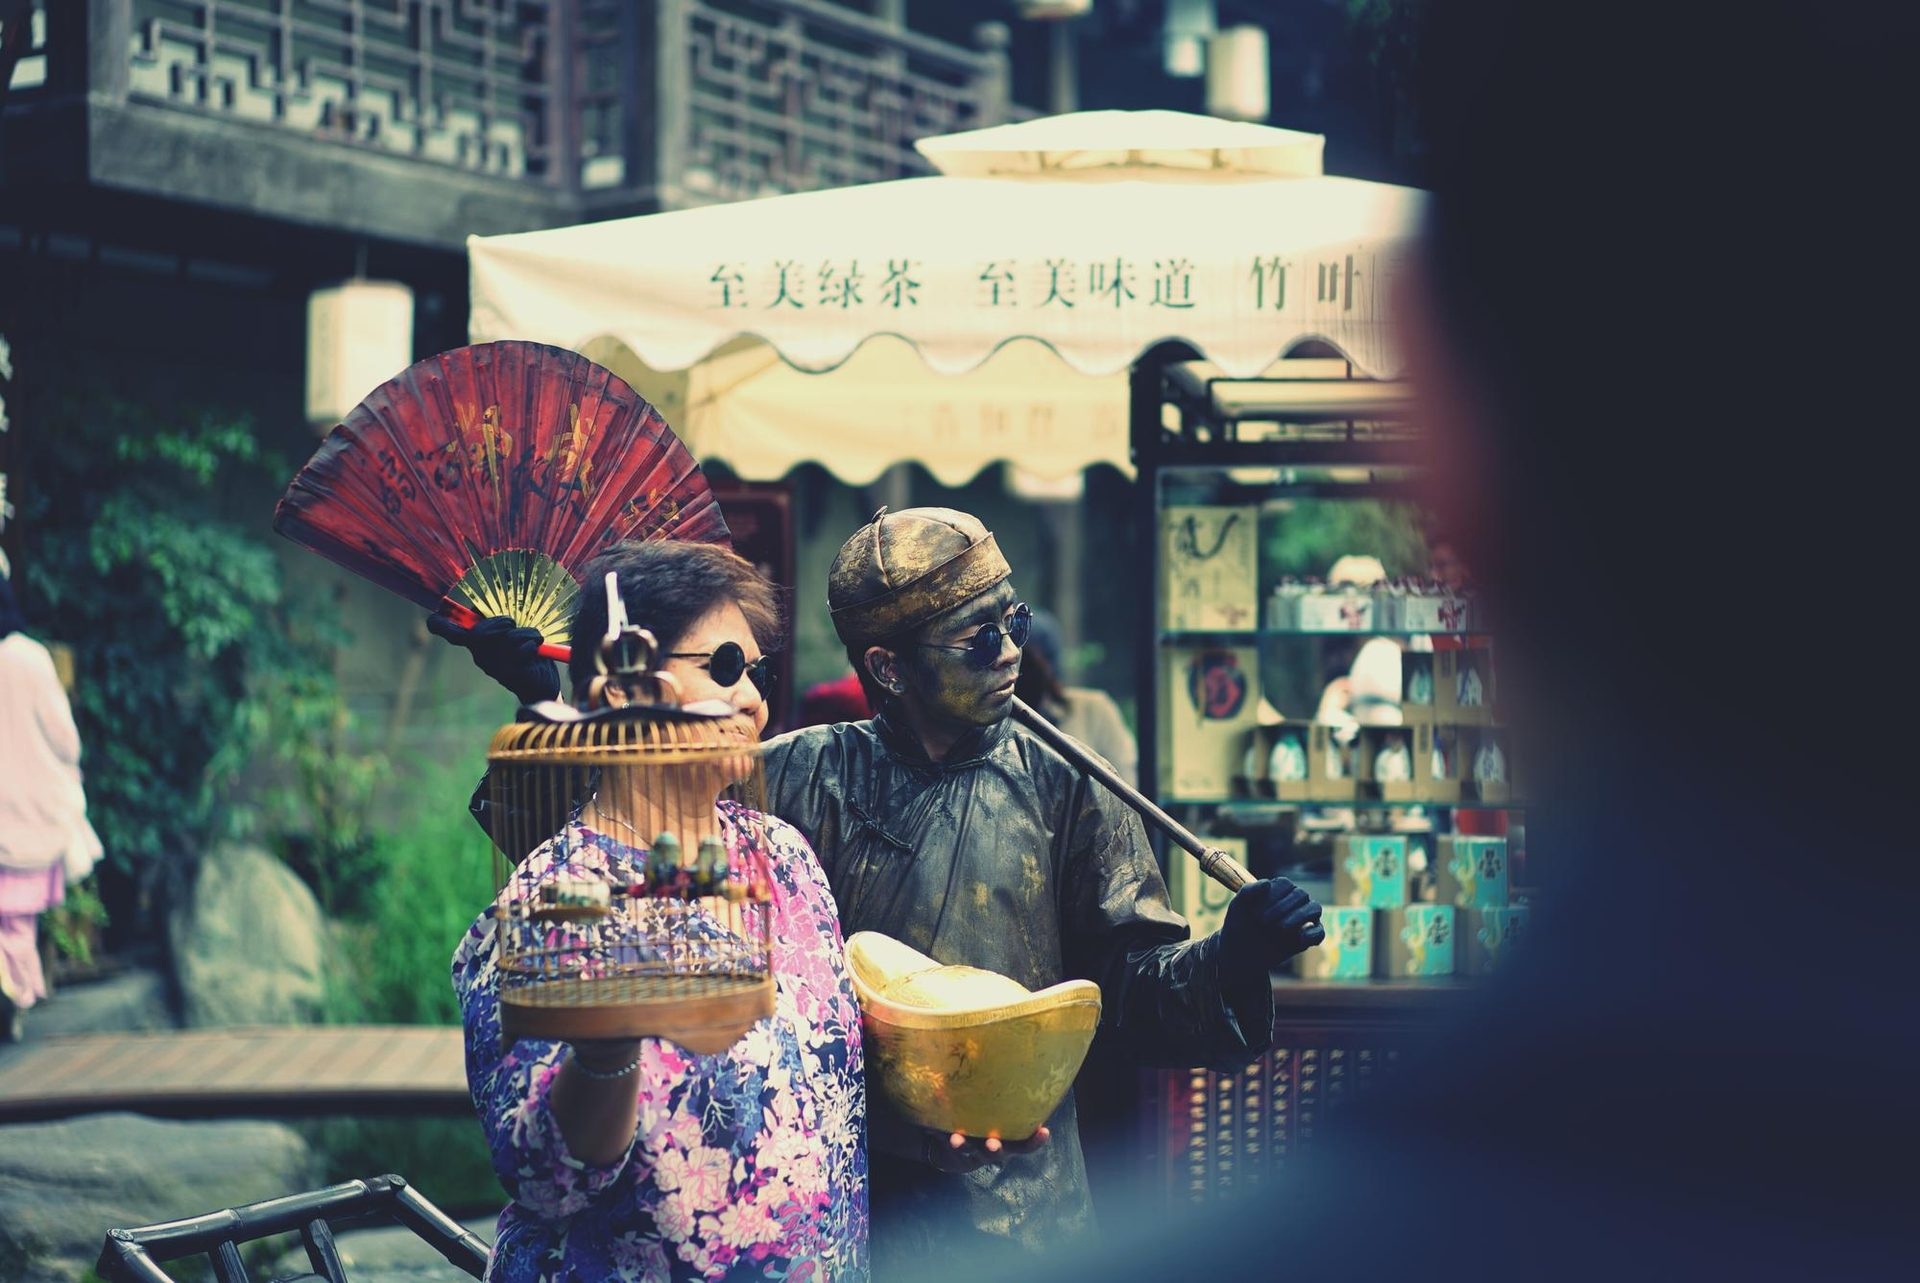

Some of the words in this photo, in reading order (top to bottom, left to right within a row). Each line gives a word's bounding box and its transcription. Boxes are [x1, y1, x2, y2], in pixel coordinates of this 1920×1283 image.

[709, 258, 922, 309] 至美绿茶
[977, 257, 1196, 309] 至美味道
